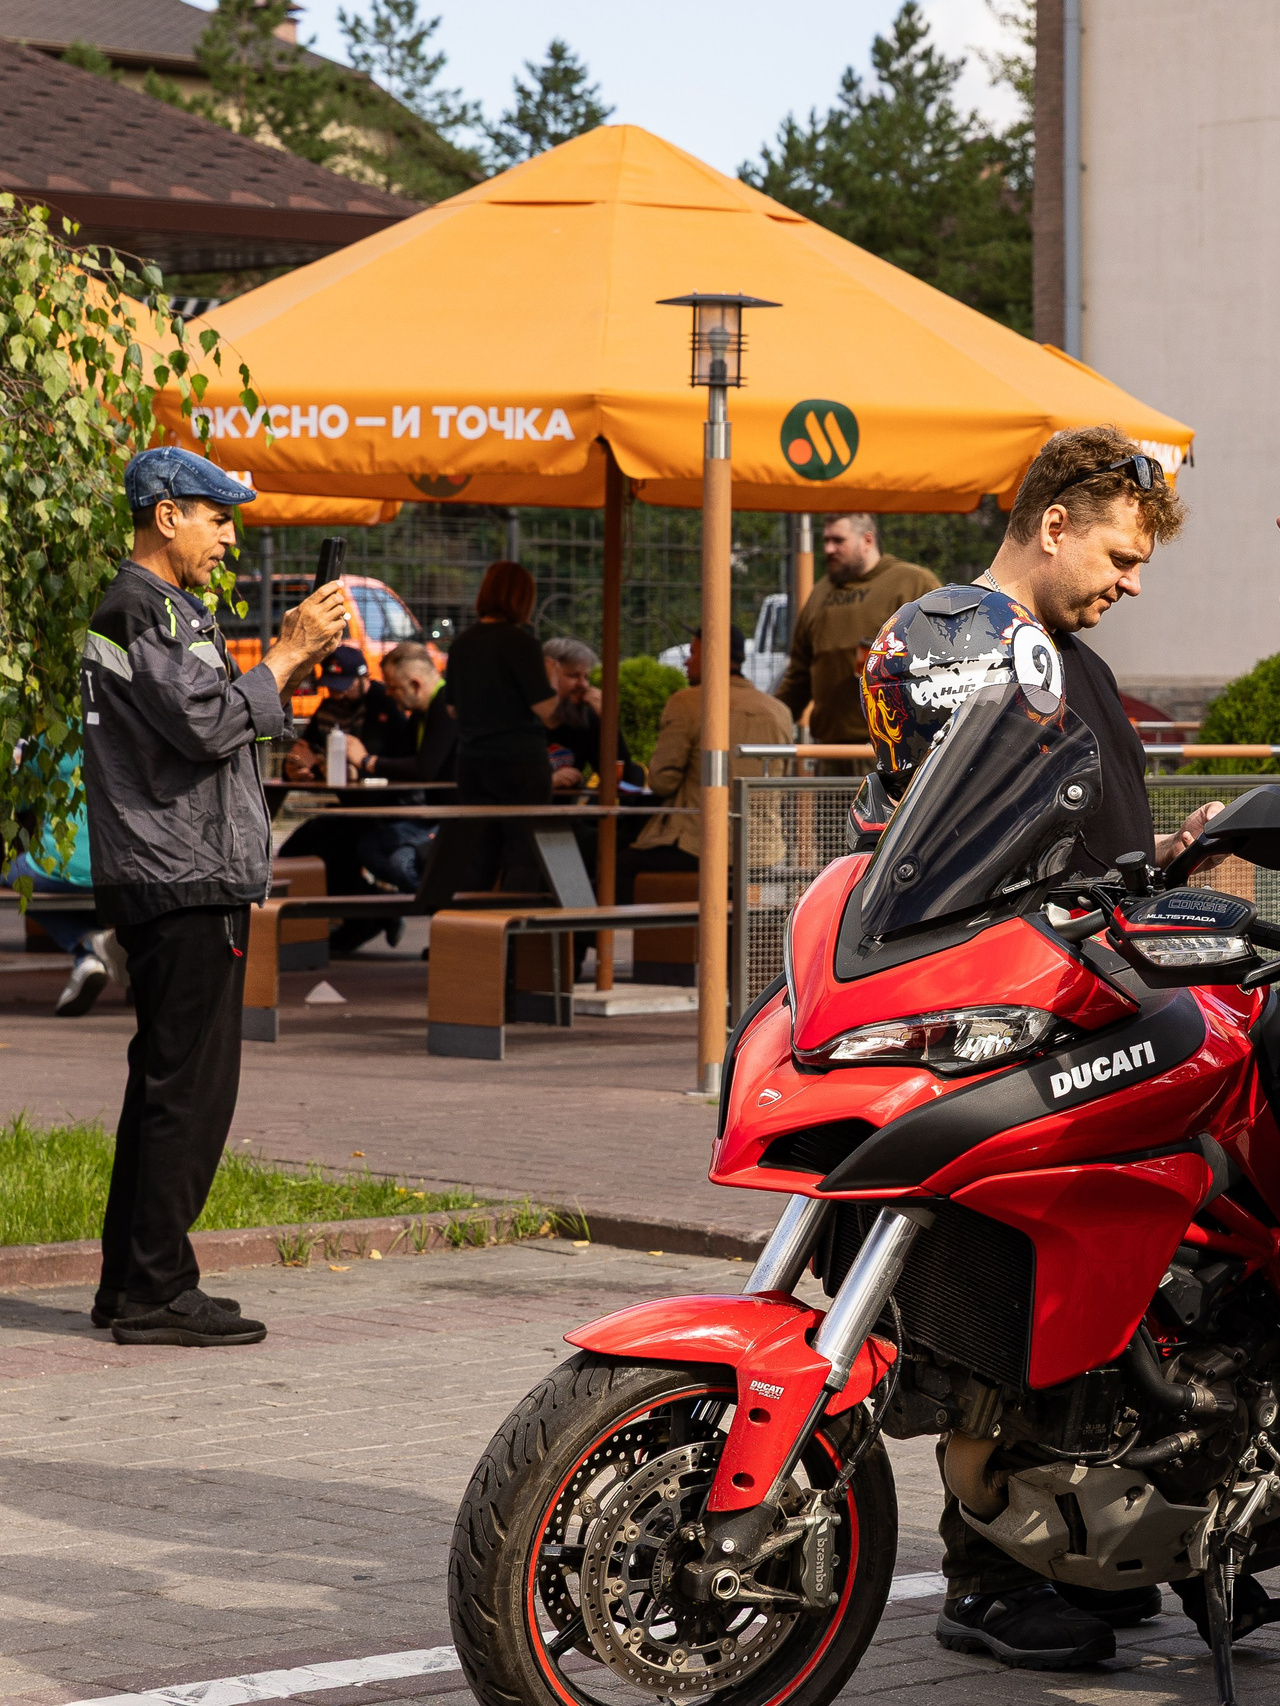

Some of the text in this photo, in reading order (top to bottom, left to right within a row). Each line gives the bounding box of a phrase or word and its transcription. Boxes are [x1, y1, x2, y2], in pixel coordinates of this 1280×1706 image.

[392, 406, 421, 439] И
[431, 405, 576, 442] ТОЧКА
[940, 684, 976, 697] HJC
[1168, 899, 1228, 914] CORSE
[1146, 913, 1217, 923] MULTISTRADA
[1050, 1040, 1156, 1099] DUCATI
[750, 1380, 785, 1397] DUCATI
[815, 1538, 828, 1592] brembo
